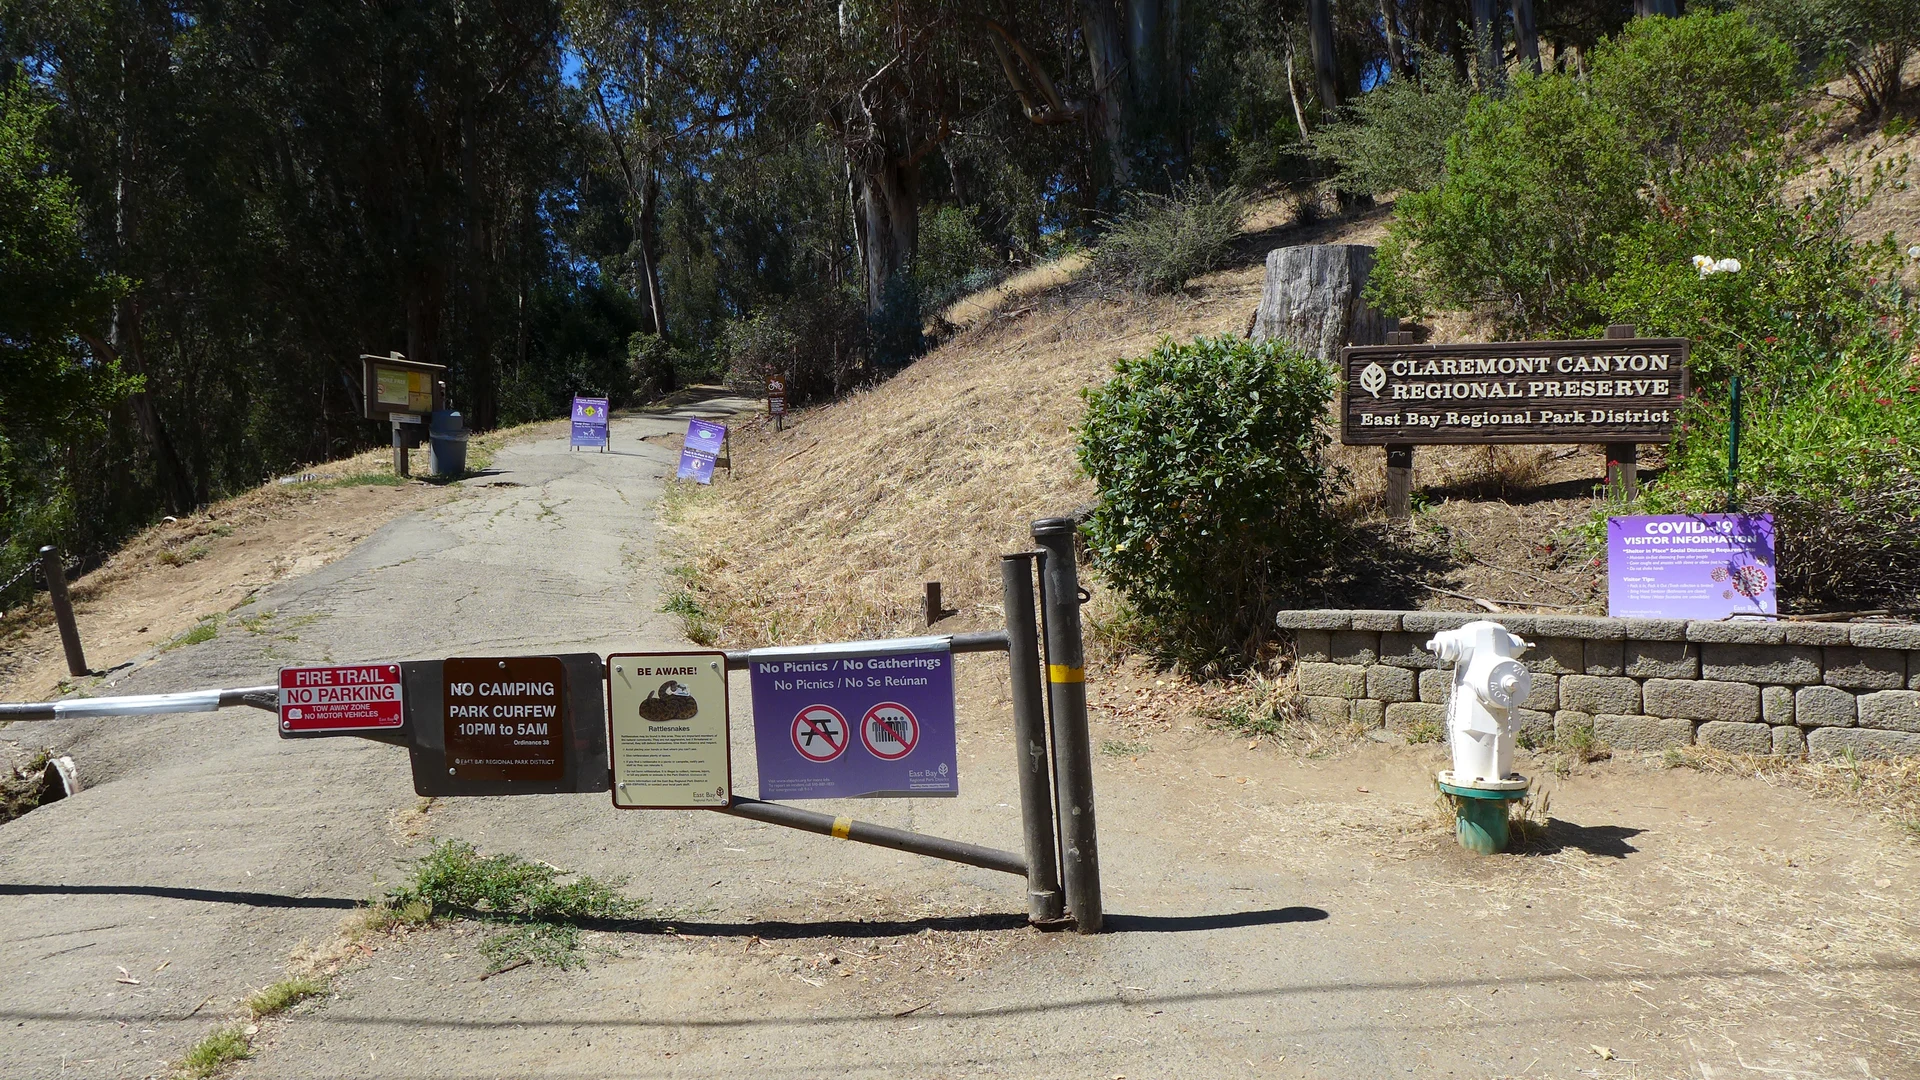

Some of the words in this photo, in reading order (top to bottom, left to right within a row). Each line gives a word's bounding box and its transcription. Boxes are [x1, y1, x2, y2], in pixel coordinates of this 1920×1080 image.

[1392, 357, 1550, 376] CLAREMONT
[1556, 354, 1669, 373] CANYON
[1392, 382, 1523, 399] REGIONAL
[1528, 380, 1669, 397] PRESERVE
[1360, 412, 1400, 426] East
[1406, 412, 1441, 428] Bay
[1446, 411, 1531, 427] Regional
[1539, 410, 1585, 424] Park
[1591, 409, 1670, 423] District
[1645, 521, 1733, 534] COVID-19
[1624, 536, 1669, 545] VISITOR
[1672, 535, 1757, 545] INFORMATION
[637, 668, 652, 676] BE
[655, 667, 697, 675] AWARE!
[759, 663, 780, 673] No
[784, 661, 828, 672] Picnics
[832, 660, 838, 671] /
[843, 660, 864, 670] No
[867, 657, 941, 670] Gatherings
[296, 671, 332, 685] FIRE
[336, 669, 384, 684] TRAIL
[774, 680, 792, 691] No
[796, 678, 834, 690] Picnics
[837, 678, 842, 689] /
[845, 677, 864, 688] No
[867, 676, 881, 687] Se
[885, 675, 928, 686] Reúnan
[287, 688, 312, 703] NO
[318, 685, 395, 702] PARKING
[450, 682, 475, 697] NO
[479, 682, 555, 696] CAMPING
[351, 703, 370, 711] ZONE
[450, 705, 489, 718] PARK
[493, 705, 556, 718] CURFEW
[459, 723, 496, 736] 10PM
[500, 723, 514, 736] to
[517, 723, 548, 735] 5AM
[909, 769, 923, 777] East
[925, 769, 938, 778] Bay
[706, 791, 716, 799] Bay
